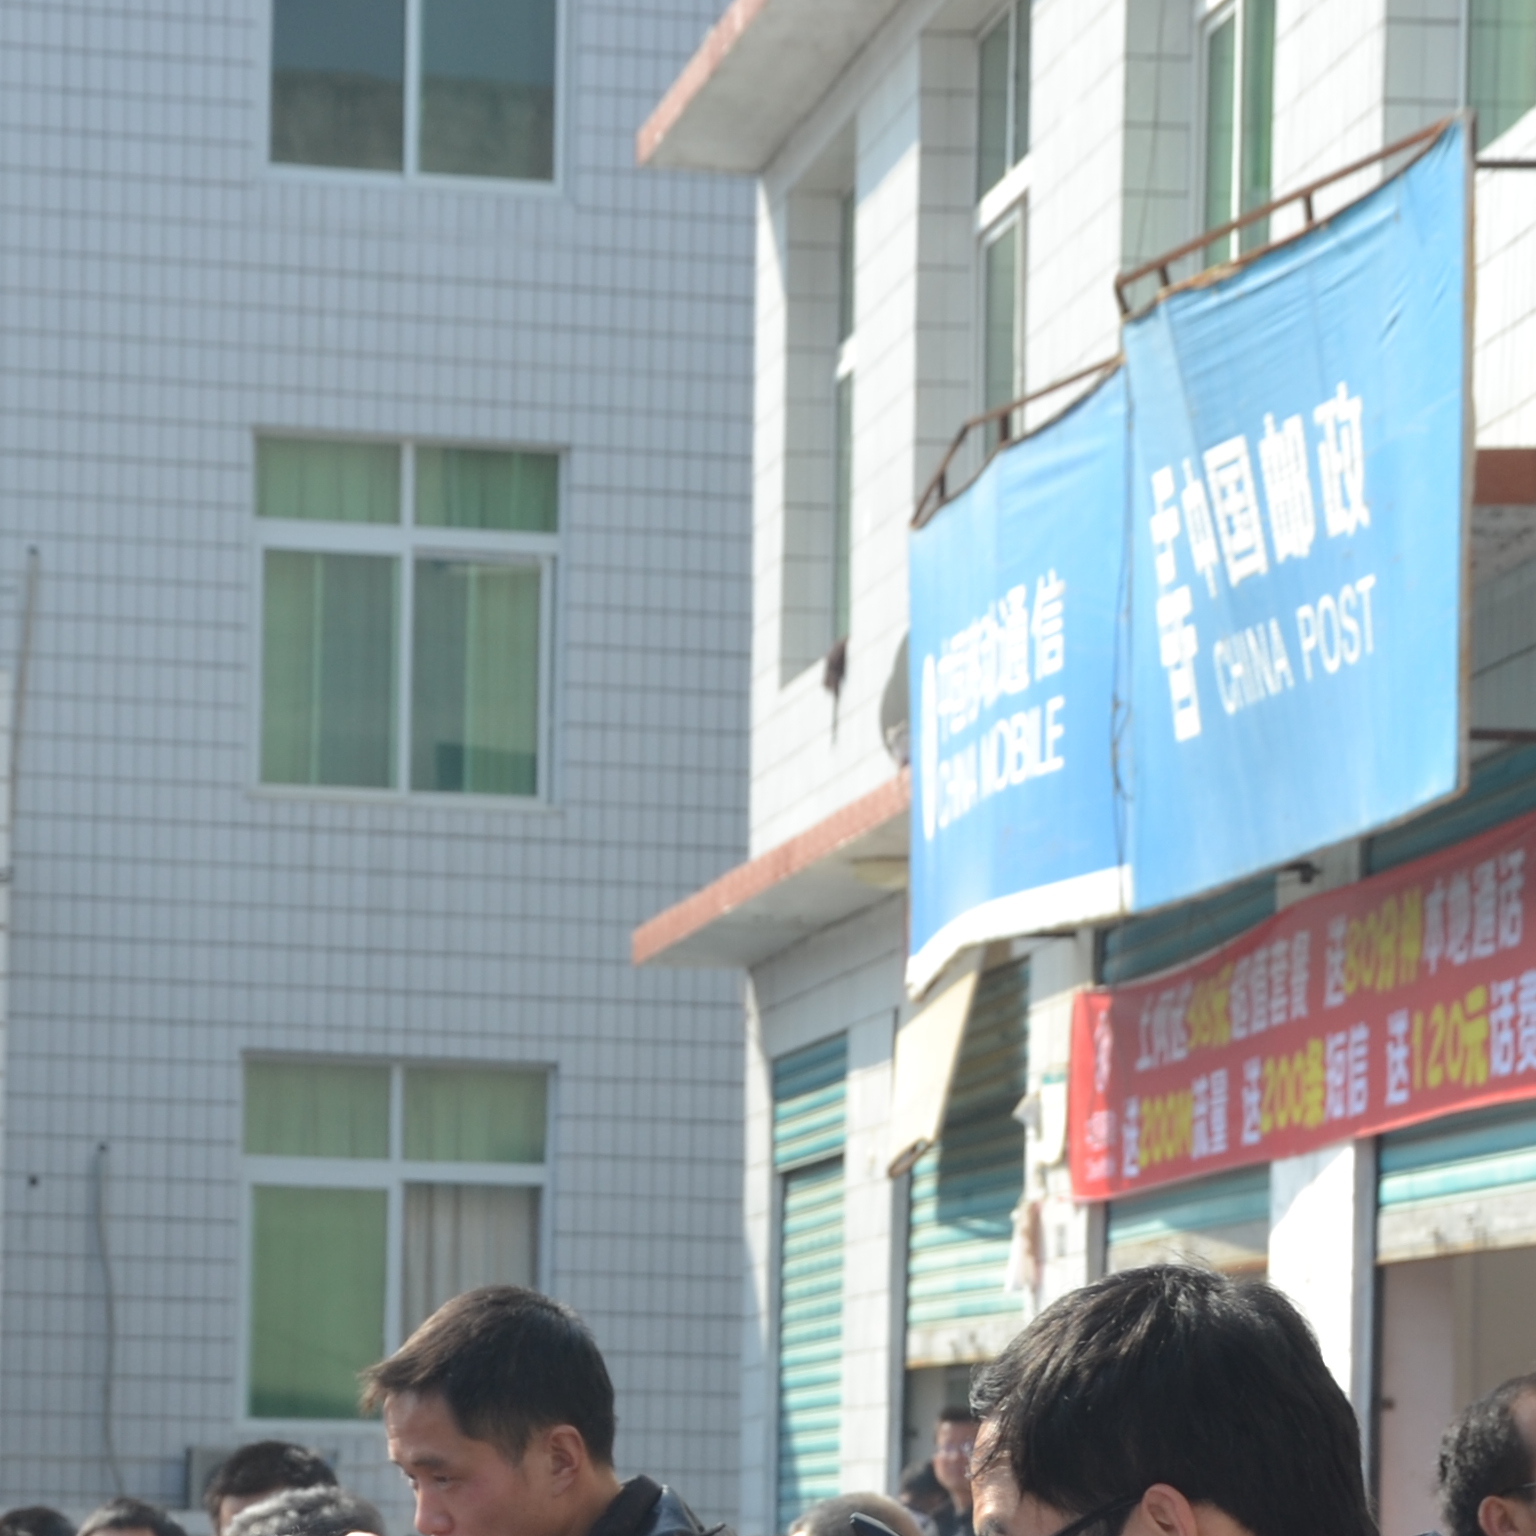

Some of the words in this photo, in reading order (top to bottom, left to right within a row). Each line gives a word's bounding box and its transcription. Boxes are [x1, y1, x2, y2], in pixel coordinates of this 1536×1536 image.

[1179, 380, 1372, 602] 中国邮政
[1213, 616, 1296, 717] CHINA
[1295, 573, 1378, 684] POST
